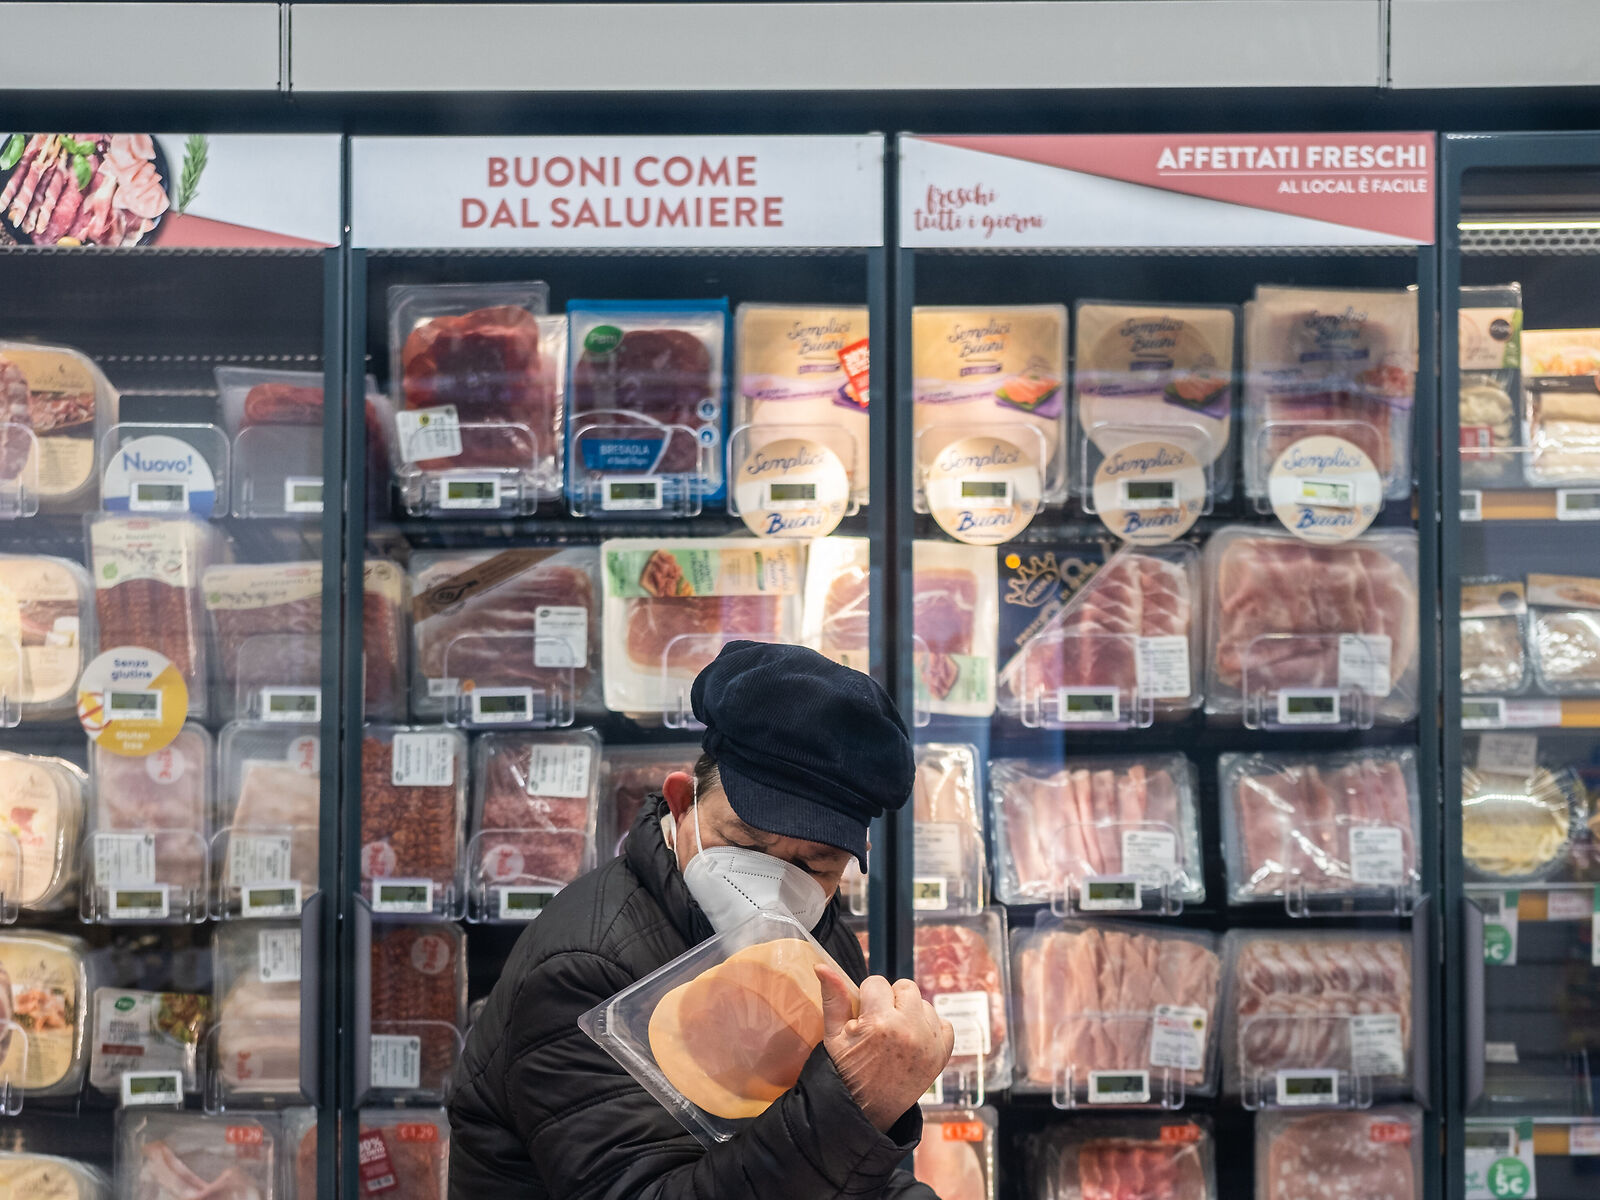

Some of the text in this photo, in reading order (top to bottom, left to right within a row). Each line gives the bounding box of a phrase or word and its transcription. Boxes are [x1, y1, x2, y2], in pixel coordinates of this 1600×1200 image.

[1157, 145, 1427, 169] AFFETTATI FRESCHI
[488, 156, 757, 187] BUONI COME
[1278, 176, 1427, 193] AL LOCAL È FACILE
[926, 182, 996, 215] freschi
[461, 197, 784, 228] DAL SALUMIERE
[914, 208, 962, 231] tutti
[122, 452, 192, 474] Nuovo!
